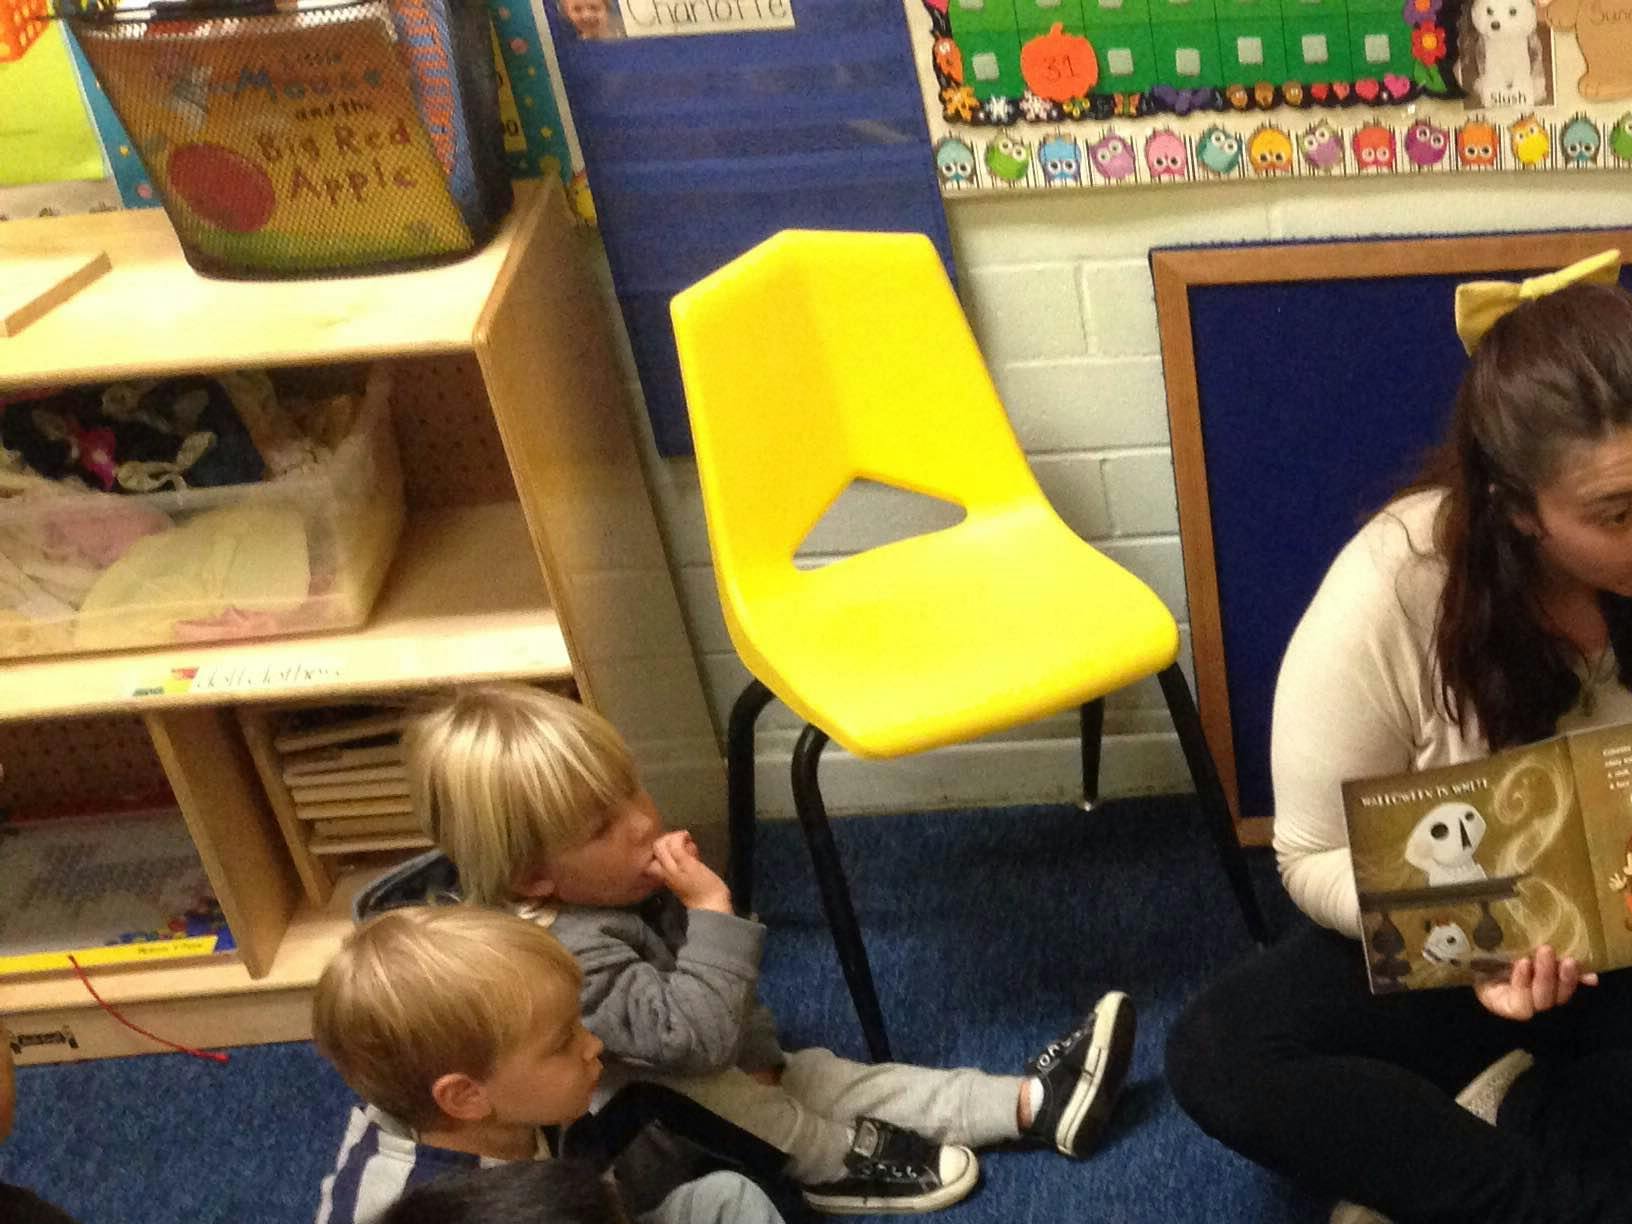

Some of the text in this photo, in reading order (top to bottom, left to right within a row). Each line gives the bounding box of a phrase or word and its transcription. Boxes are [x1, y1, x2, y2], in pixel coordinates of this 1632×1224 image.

[627, 0, 788, 26] Charlotte
[1042, 54, 1077, 84] 31
[1490, 90, 1527, 105] Slush
